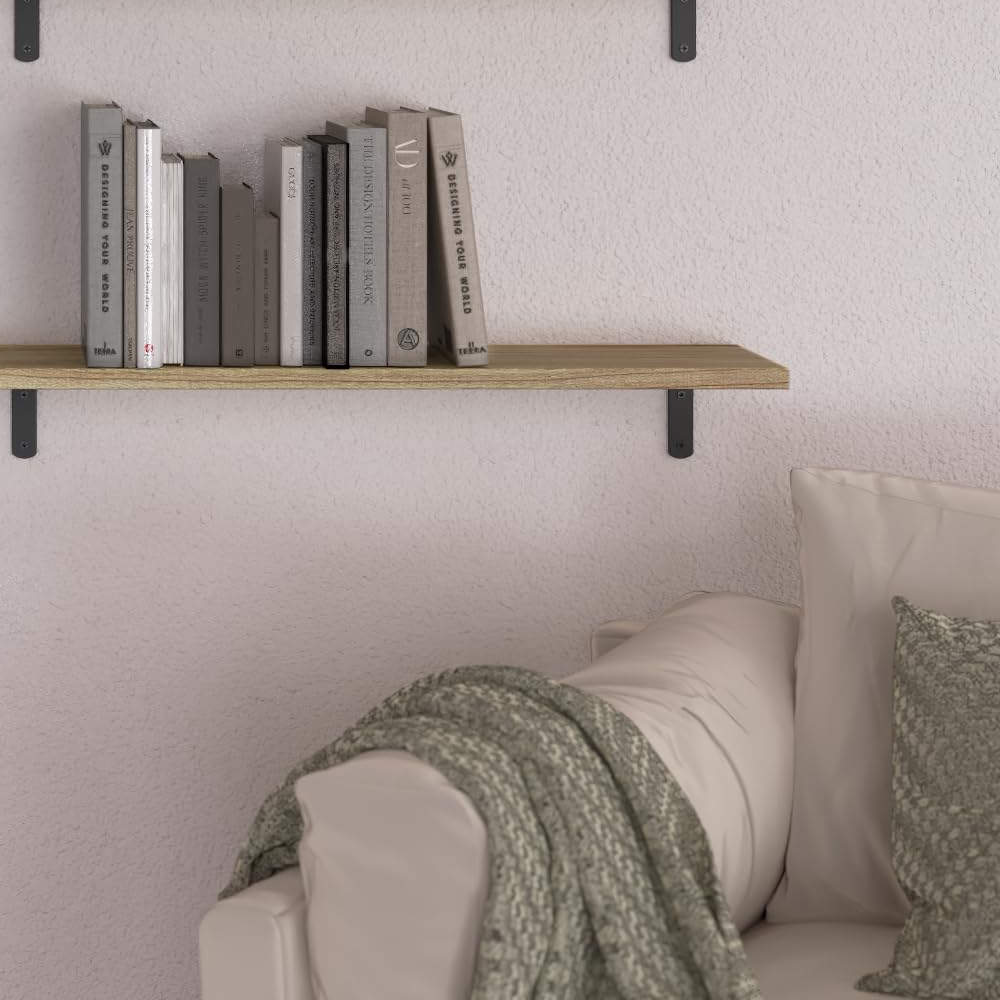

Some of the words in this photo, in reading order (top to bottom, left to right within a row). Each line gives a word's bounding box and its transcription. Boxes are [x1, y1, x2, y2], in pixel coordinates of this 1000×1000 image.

[101, 164, 110, 229] DESIGNING
[447, 174, 463, 236] DESIGNING
[101, 234, 110, 266] YOUR
[456, 240, 467, 270] YOUR
[101, 273, 110, 313] WORLD
[363, 268, 374, 305] BOOK
[460, 277, 472, 315] WORLD
